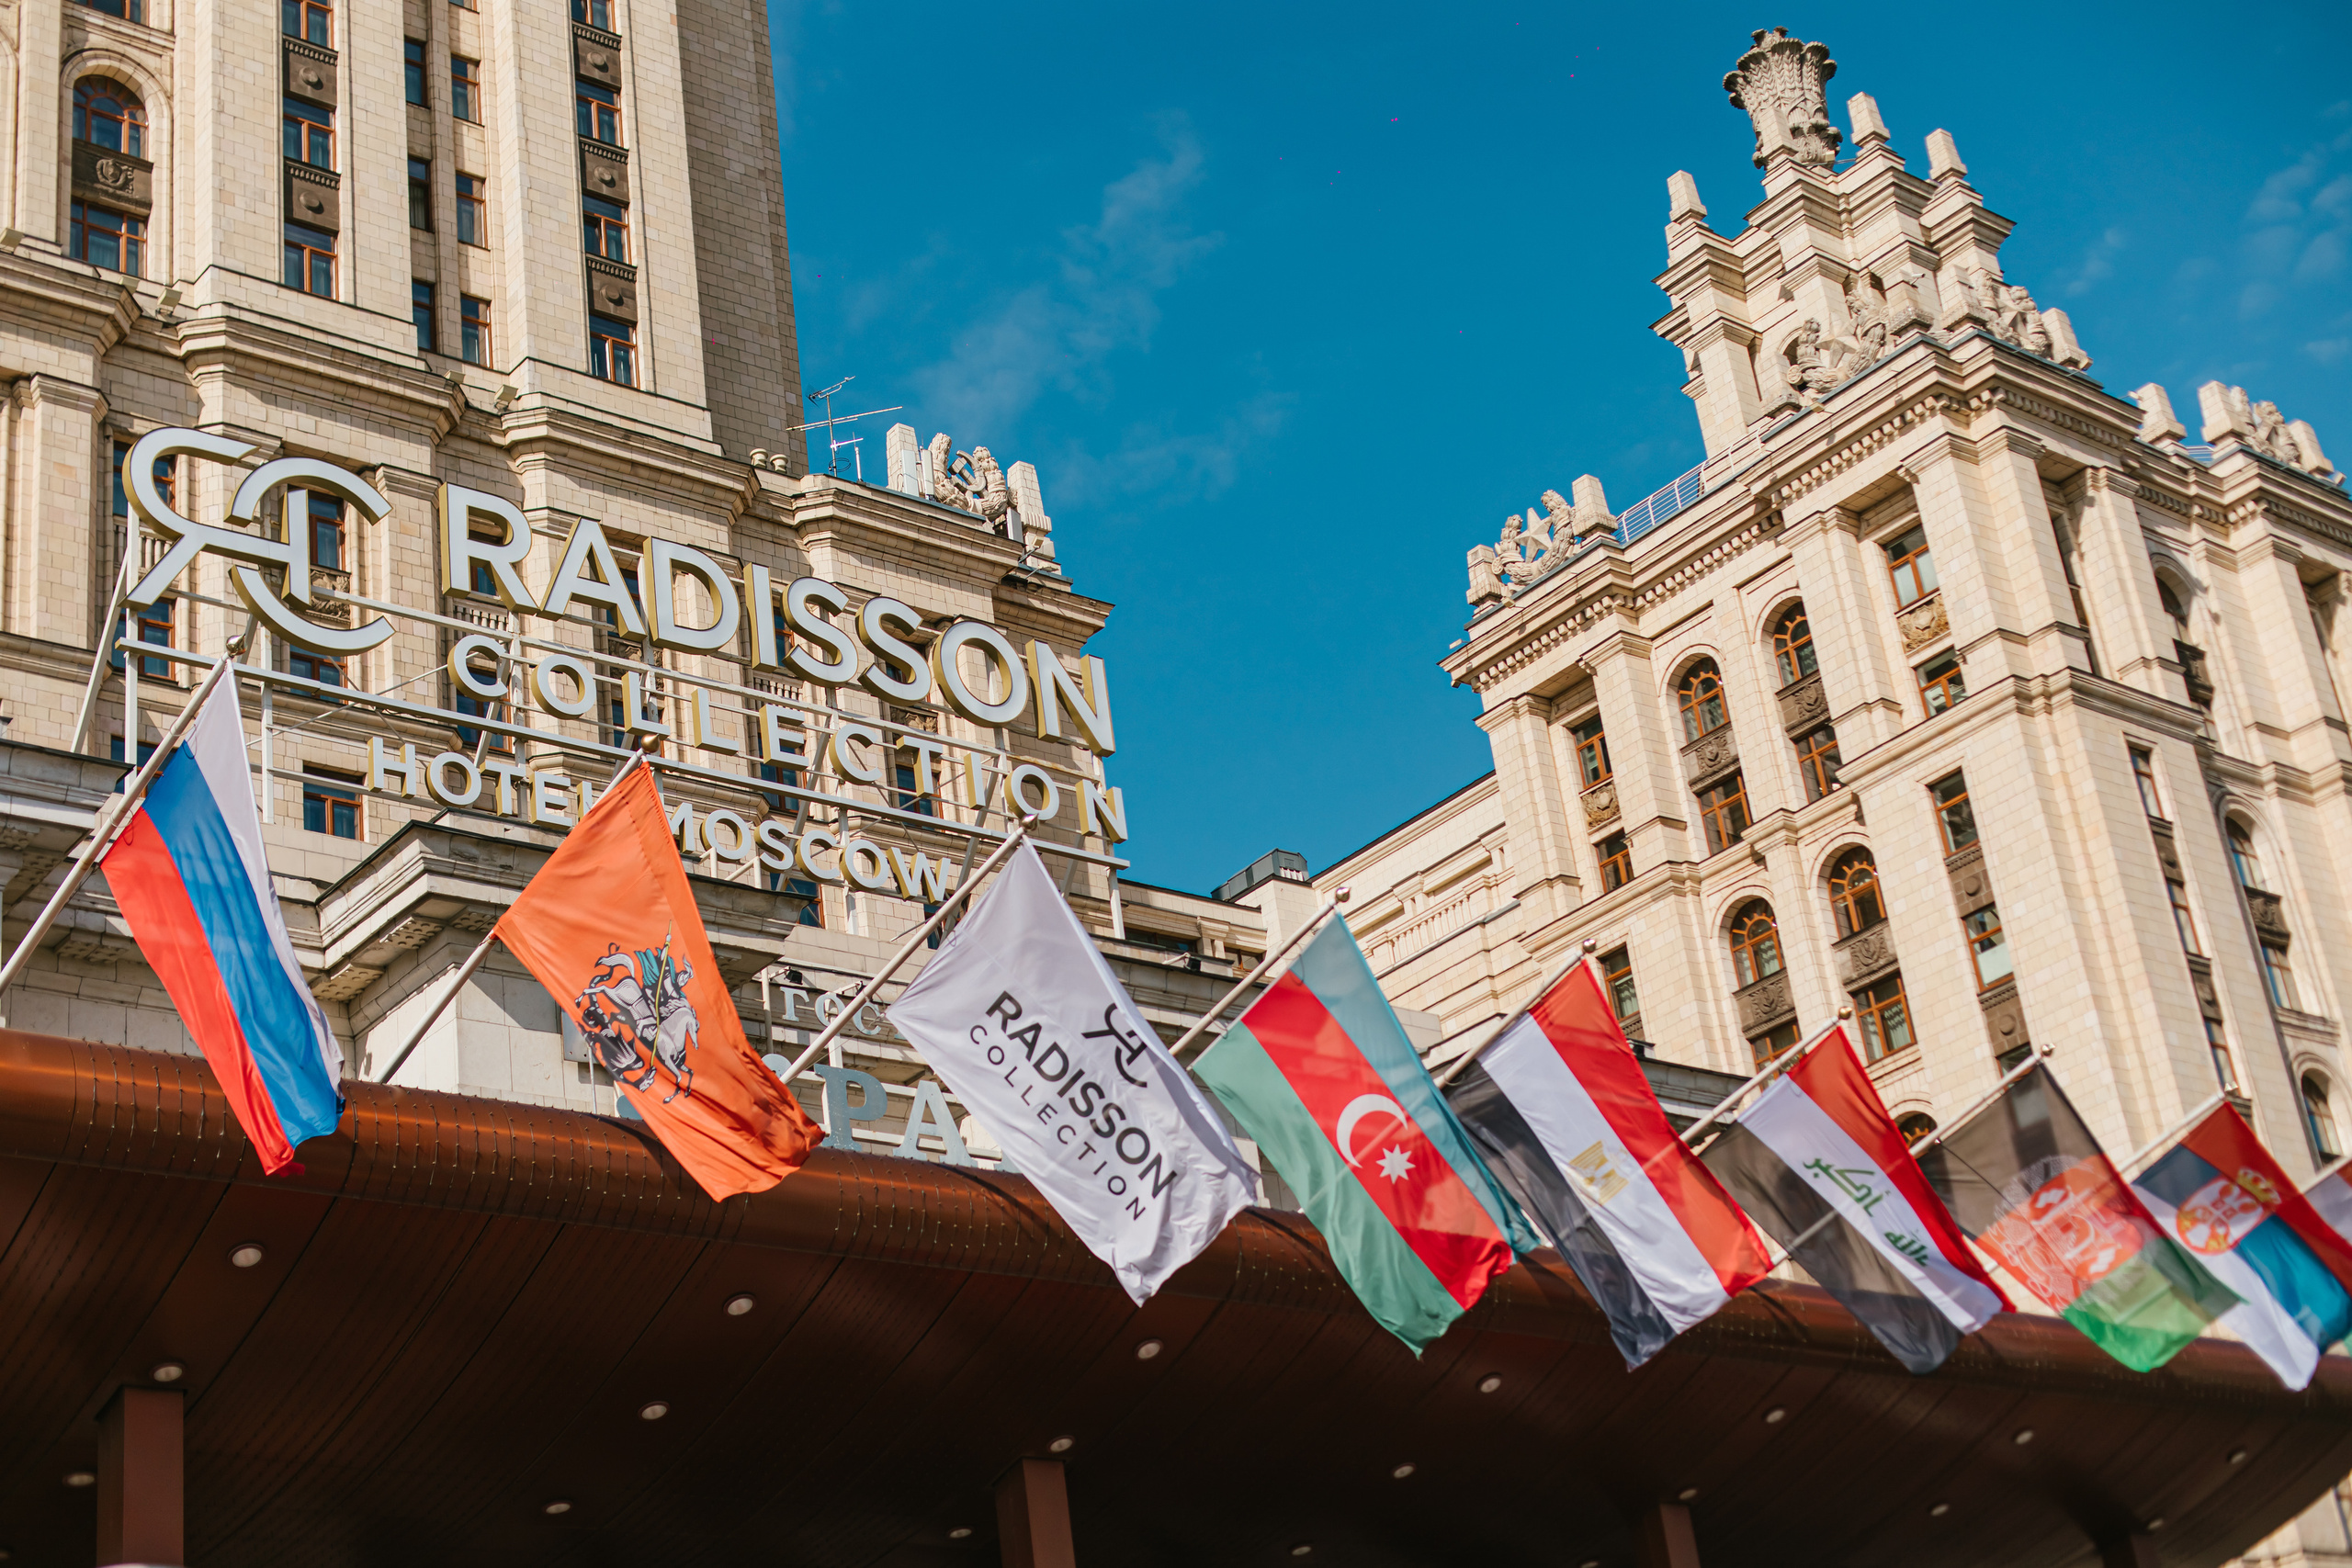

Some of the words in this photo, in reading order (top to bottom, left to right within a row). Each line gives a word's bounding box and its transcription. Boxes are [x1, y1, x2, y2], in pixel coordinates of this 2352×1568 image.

[438, 482, 1115, 757] RADISSON
[447, 634, 1128, 843] COLLECTION
[970, 1024, 1146, 1221] COLLECTION
[985, 990, 1178, 1199] RADISSON
